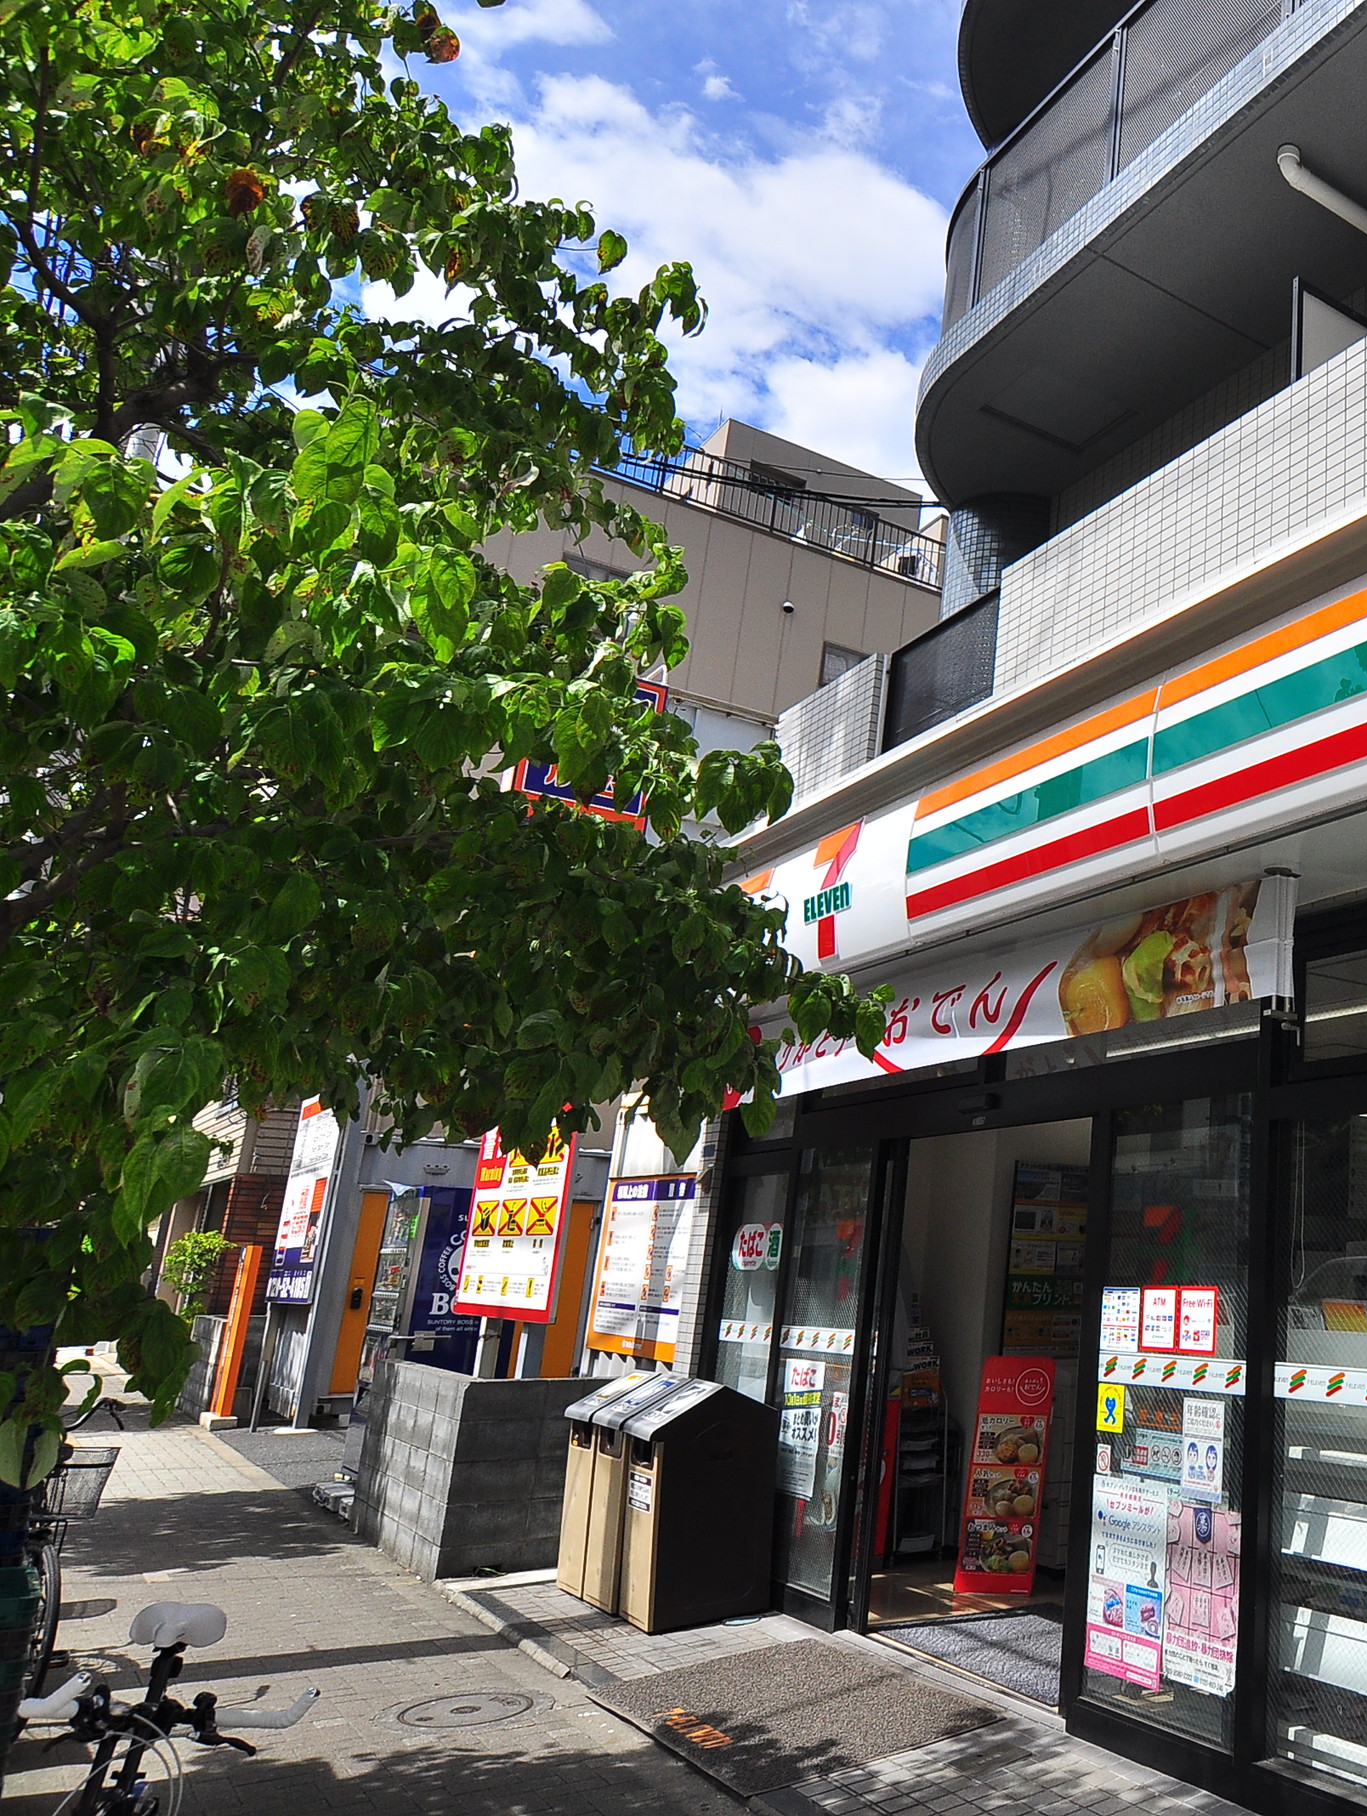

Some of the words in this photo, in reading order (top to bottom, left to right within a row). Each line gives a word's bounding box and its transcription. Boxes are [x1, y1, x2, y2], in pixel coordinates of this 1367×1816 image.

[738, 1229, 765, 1258] たばこ
[767, 1229, 781, 1258] 酒
[438, 1245, 454, 1274] COFFEE
[1152, 1297, 1167, 1307] ATM
[1183, 1298, 1196, 1308] Free
[790, 1366, 818, 1388] たばこ
[1108, 1514, 1131, 1532] Google
